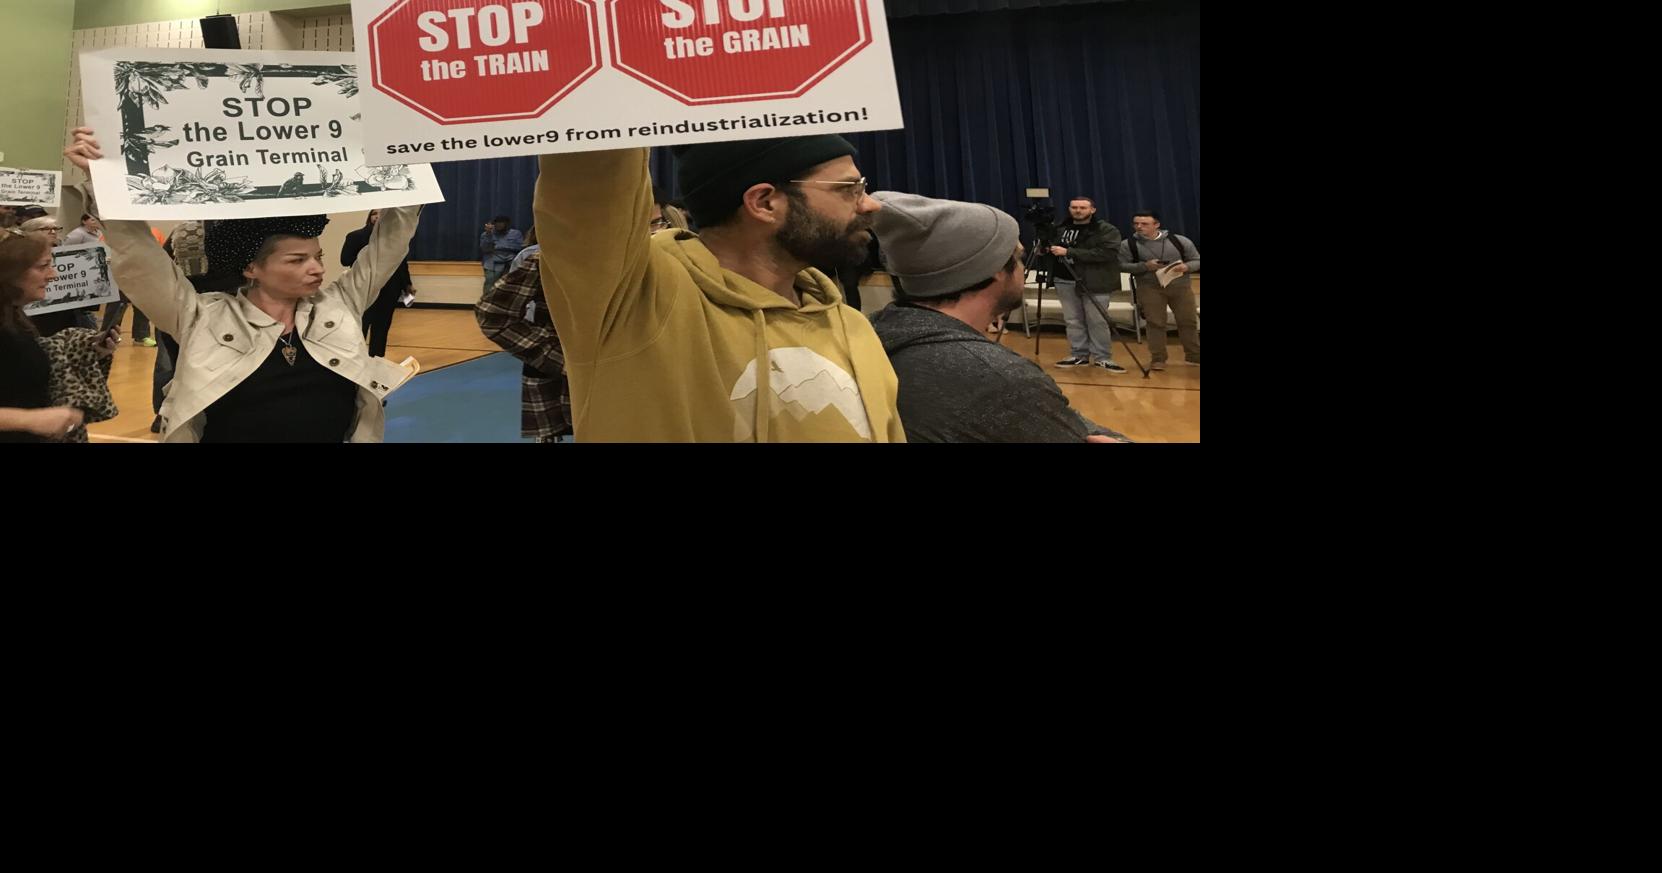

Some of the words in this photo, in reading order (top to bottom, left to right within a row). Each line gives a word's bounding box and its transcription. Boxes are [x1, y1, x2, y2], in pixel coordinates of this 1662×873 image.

[417, 1, 544, 52] STOP
[664, 36, 714, 59] the
[722, 24, 810, 54] GRAIN
[420, 59, 467, 81] the
[473, 50, 549, 77] TRAIN
[222, 97, 312, 118] STOP
[182, 122, 228, 142] the
[238, 120, 320, 141] Lower
[328, 120, 343, 139] 9
[386, 142, 436, 155] save
[440, 137, 478, 151] the
[484, 130, 559, 147] lower9
[565, 127, 621, 142] from
[628, 107, 868, 137] reindustrialization!
[186, 150, 249, 168] Grain
[256, 146, 349, 165] Terminal
[57, 262, 75, 273] OP
[80, 270, 87, 279] 9
[54, 280, 89, 292] Terminal
